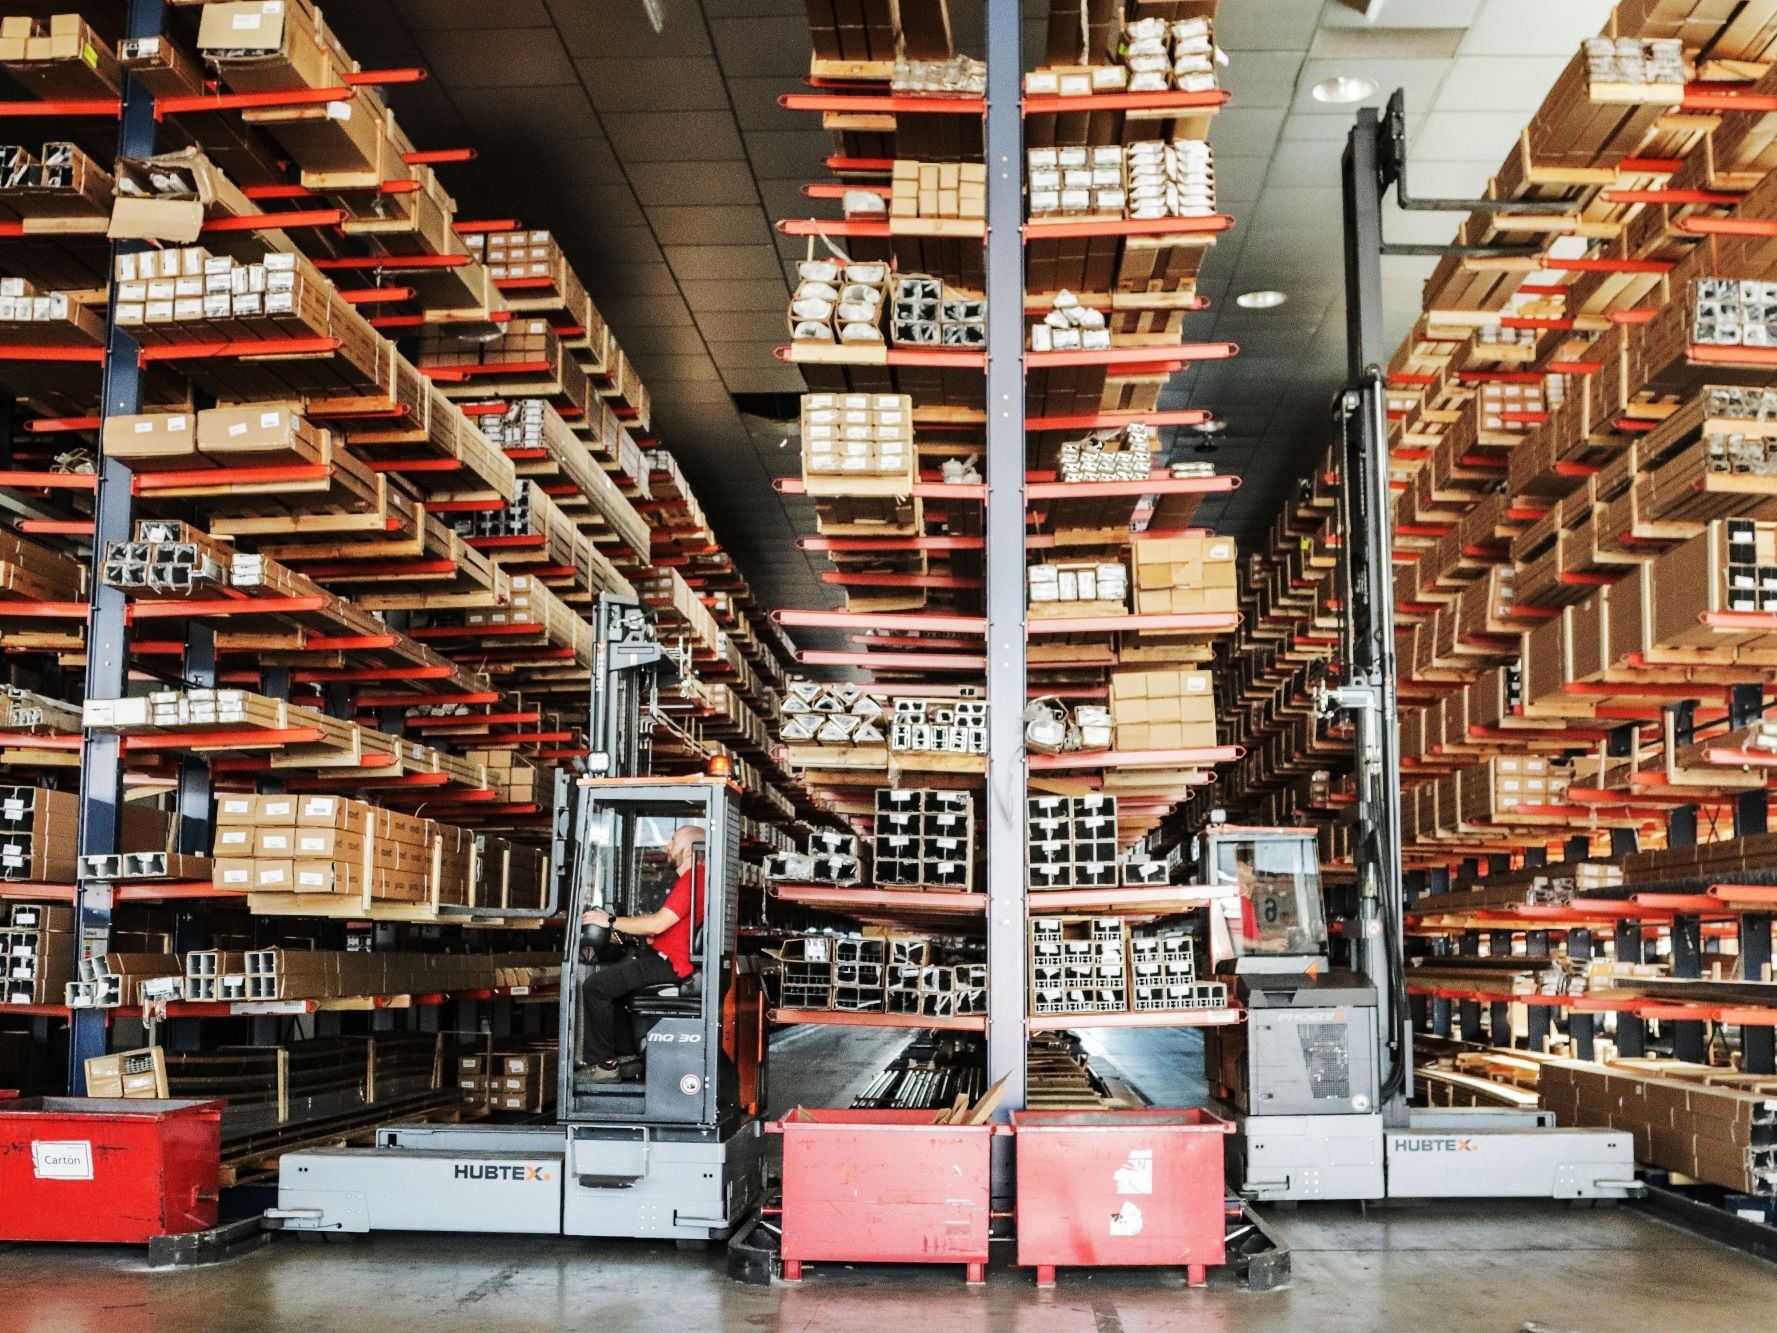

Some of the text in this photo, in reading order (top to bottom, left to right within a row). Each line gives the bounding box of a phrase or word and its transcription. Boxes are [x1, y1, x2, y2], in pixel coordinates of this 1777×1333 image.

[647, 1033, 701, 1043] MQ 30
[44, 1154, 81, 1165] Cartón
